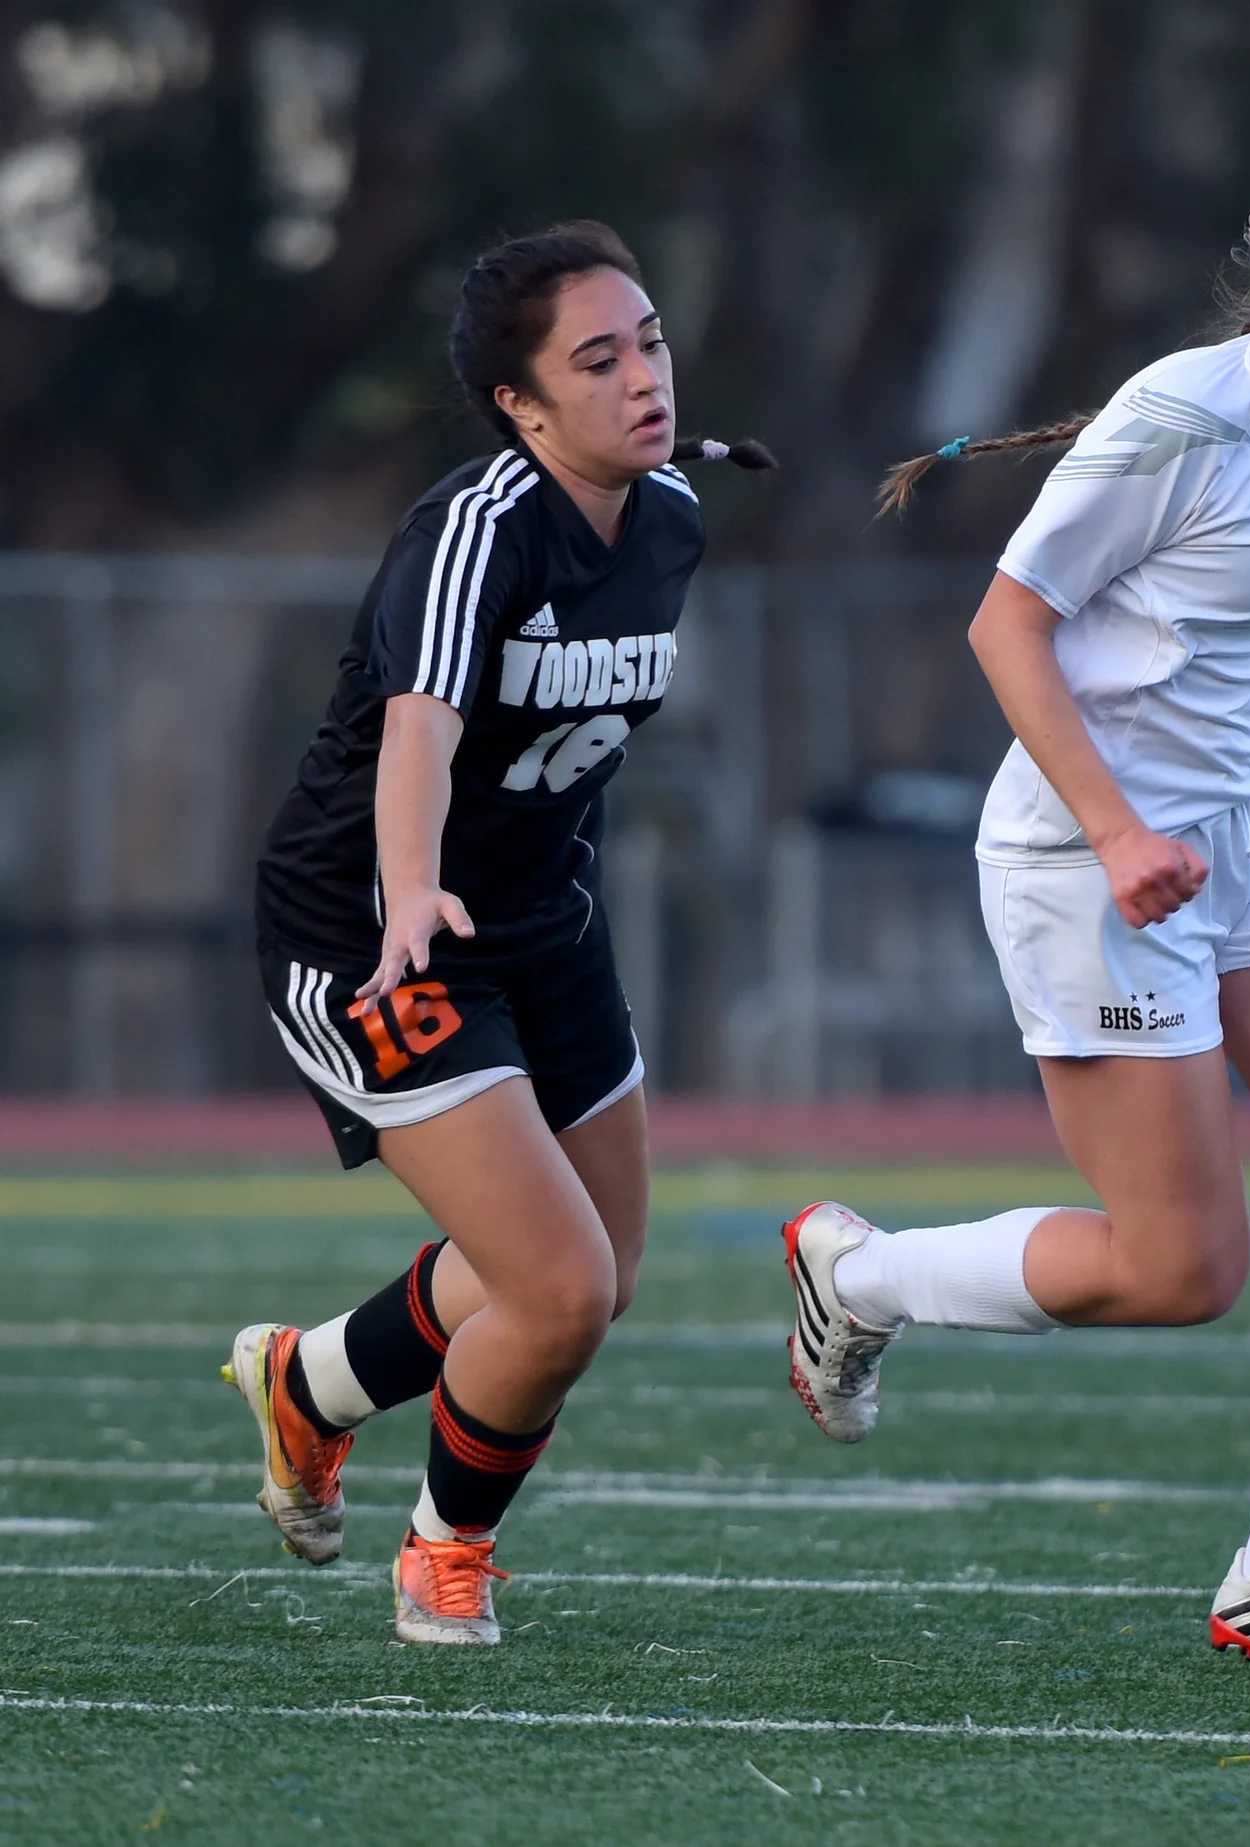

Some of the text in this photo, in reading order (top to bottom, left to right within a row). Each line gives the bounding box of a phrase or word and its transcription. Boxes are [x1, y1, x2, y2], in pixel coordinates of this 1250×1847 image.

[520, 625, 559, 637] adidas
[346, 981, 463, 1080] 16
[1099, 1006, 1186, 1031] BHS Soccer
